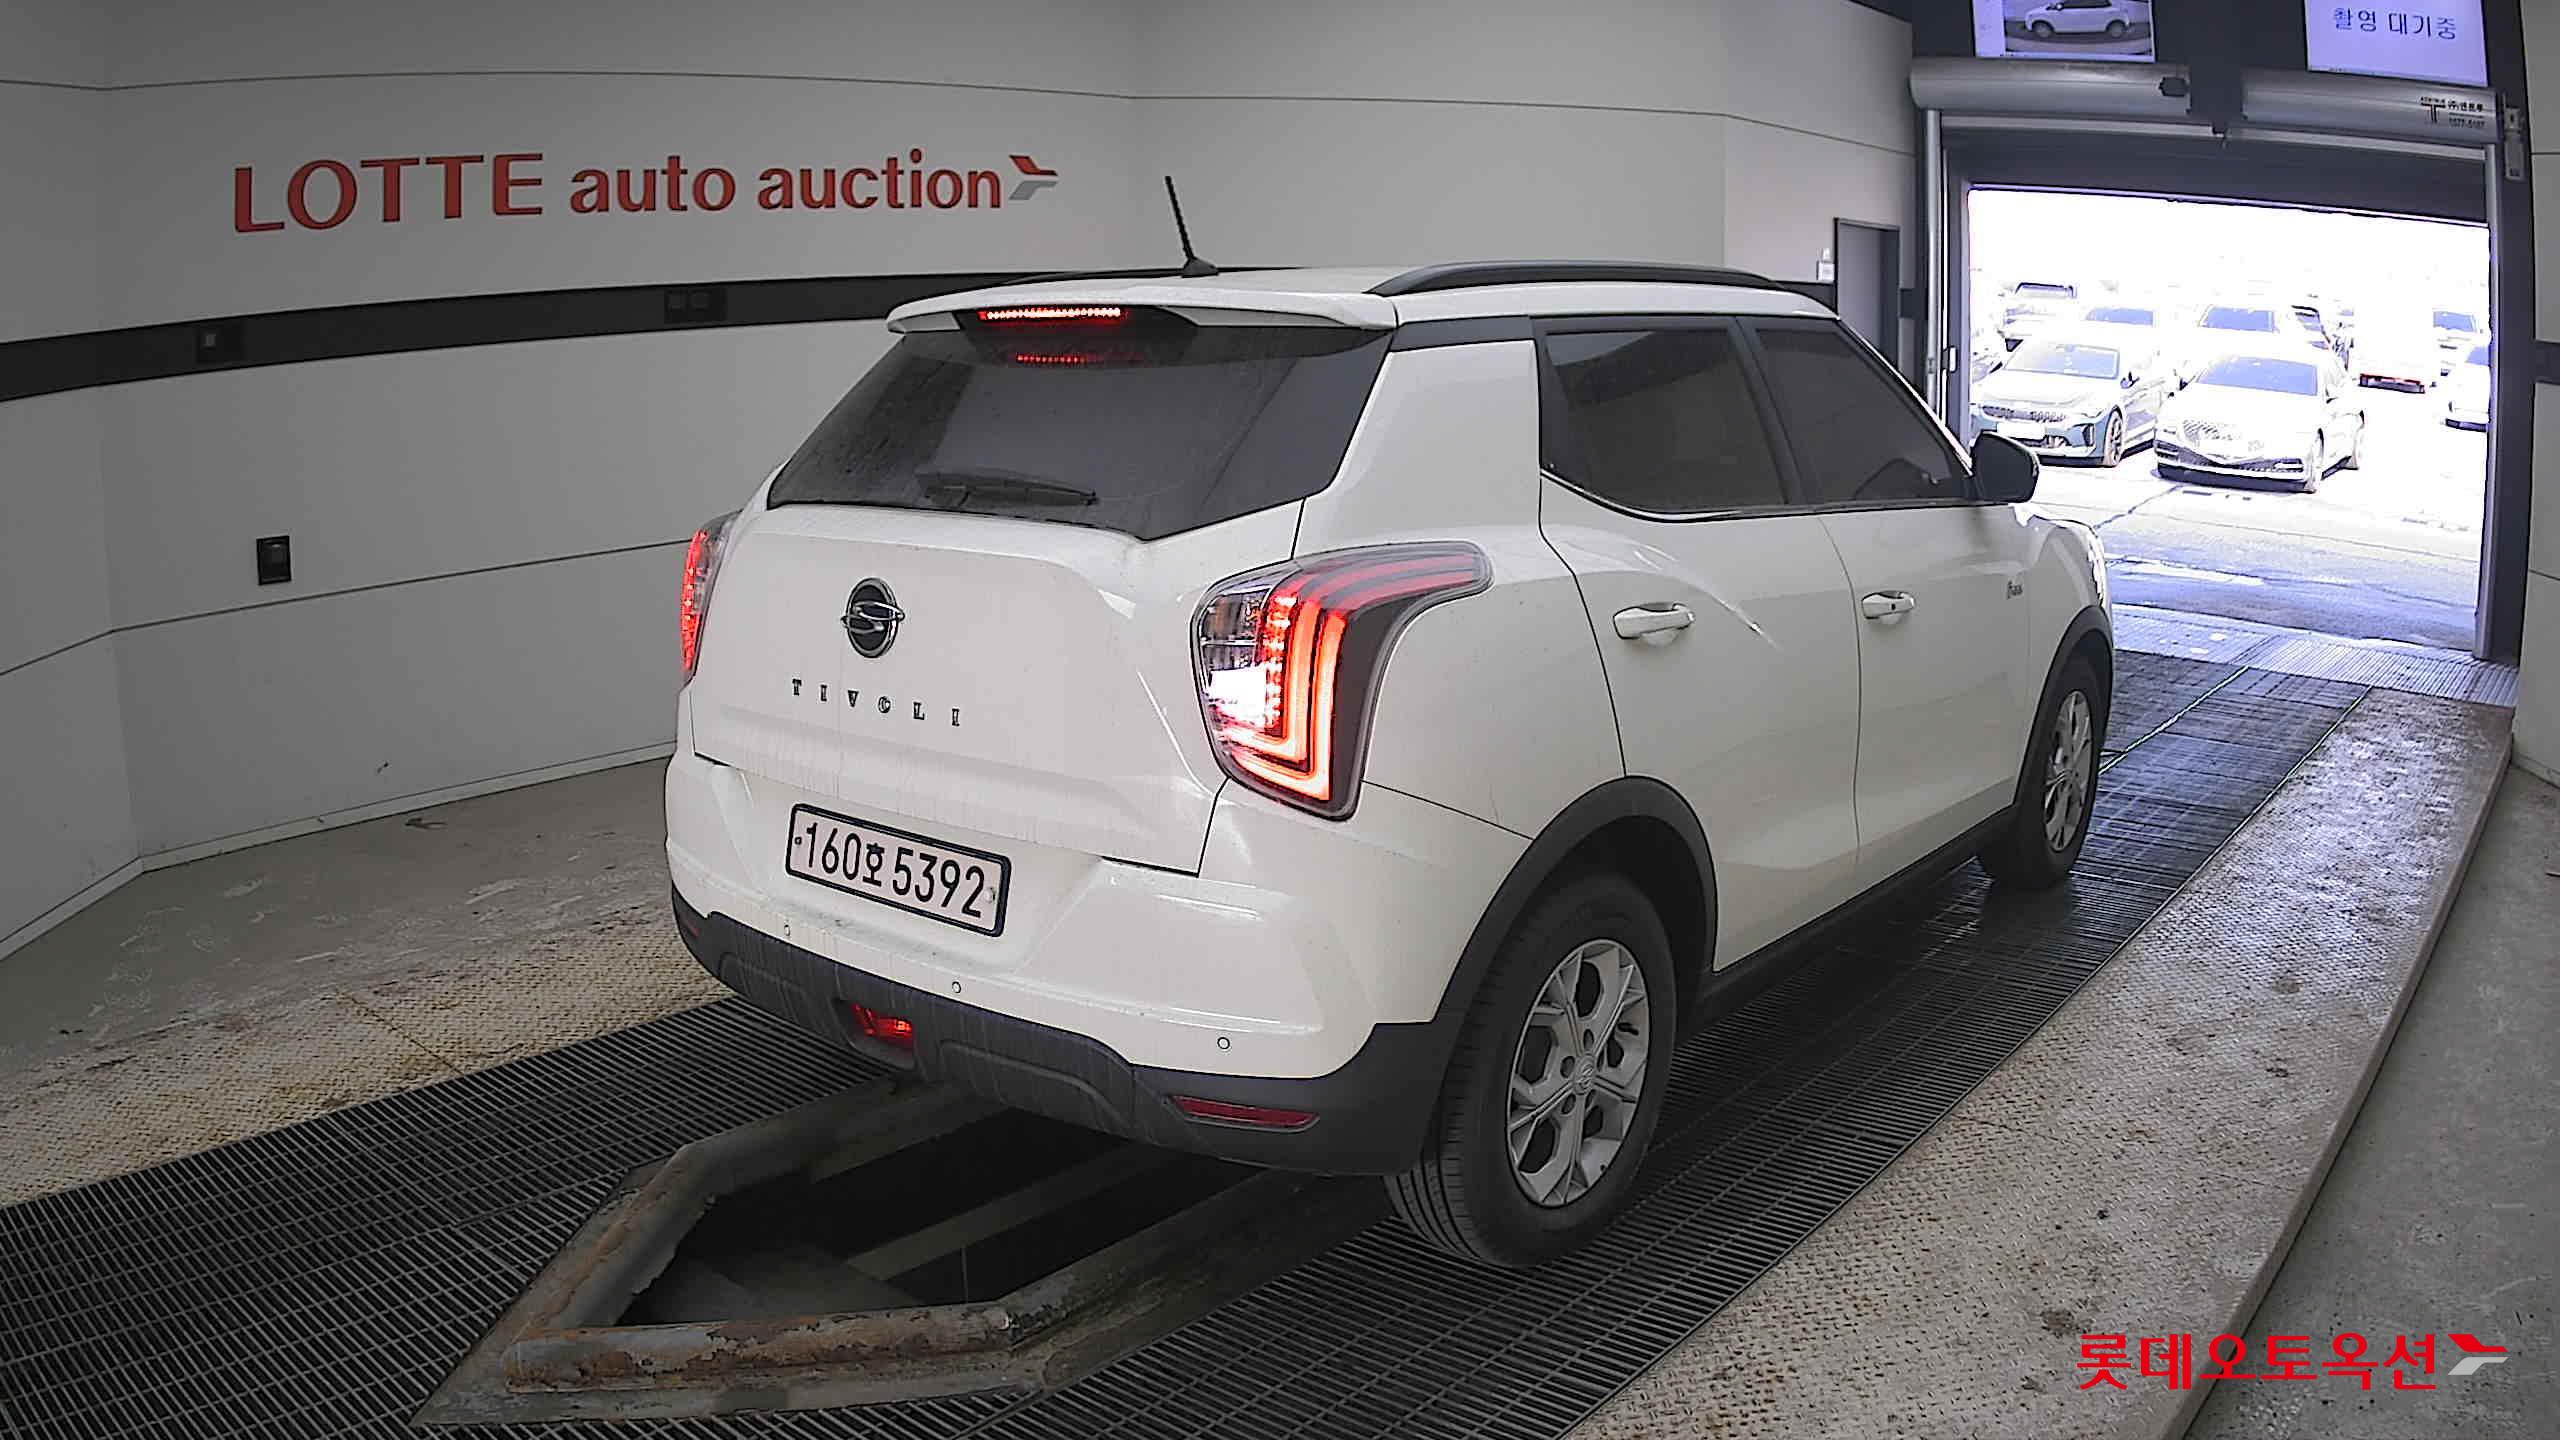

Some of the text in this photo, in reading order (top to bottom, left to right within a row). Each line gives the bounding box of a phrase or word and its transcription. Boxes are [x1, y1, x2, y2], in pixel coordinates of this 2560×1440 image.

[235, 148, 1003, 233] LOTTE auto auction
[791, 678, 960, 727] TIVOLI
